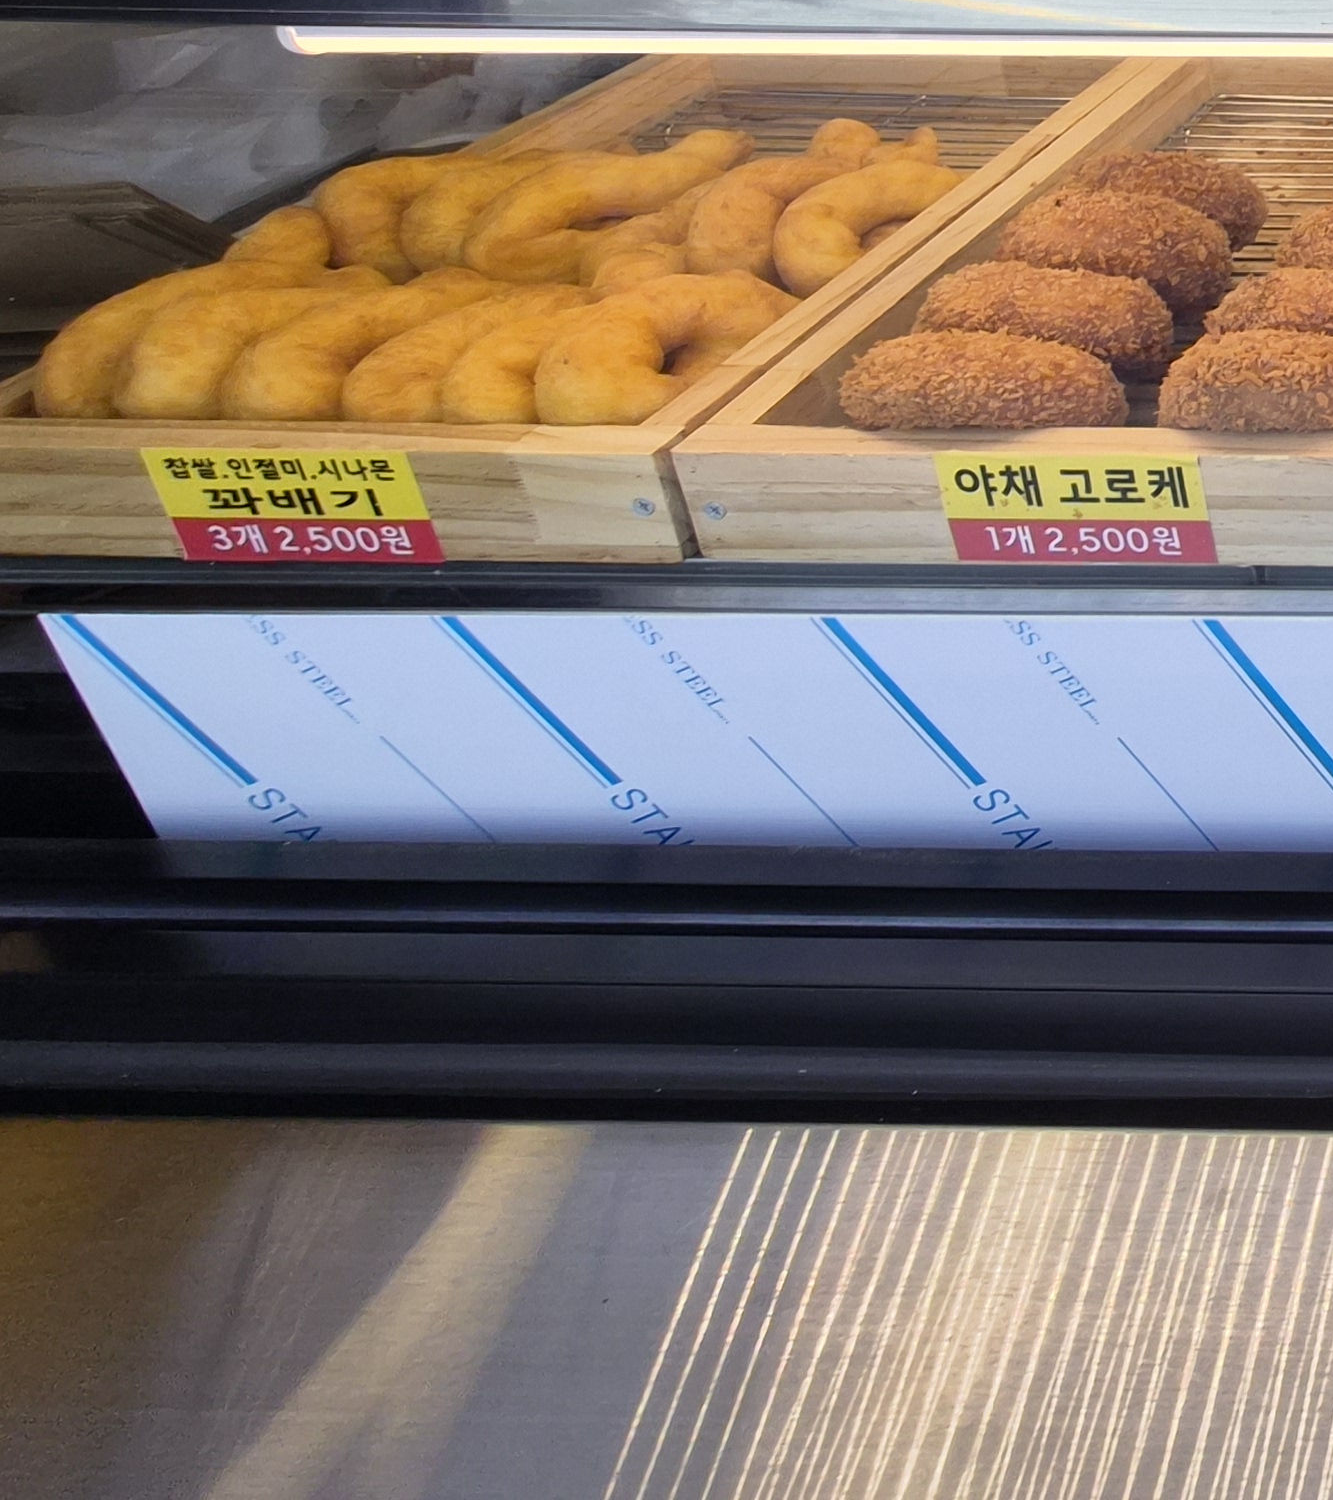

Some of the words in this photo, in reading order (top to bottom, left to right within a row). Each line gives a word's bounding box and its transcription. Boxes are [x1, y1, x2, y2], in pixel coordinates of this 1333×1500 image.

[203, 487, 384, 516] 꽈배기
[954, 464, 1044, 508] 야채
[1059, 466, 1191, 509] 고로케
[207, 524, 270, 554] 3개
[273, 525, 415, 556] 2,500원
[984, 525, 1036, 555] 1개
[1045, 526, 1183, 556] 2,500원
[285, 649, 355, 709] STEEL
[660, 649, 727, 710] STEEL
[1036, 650, 1099, 710] STEEL
[611, 788, 695, 845] STA
